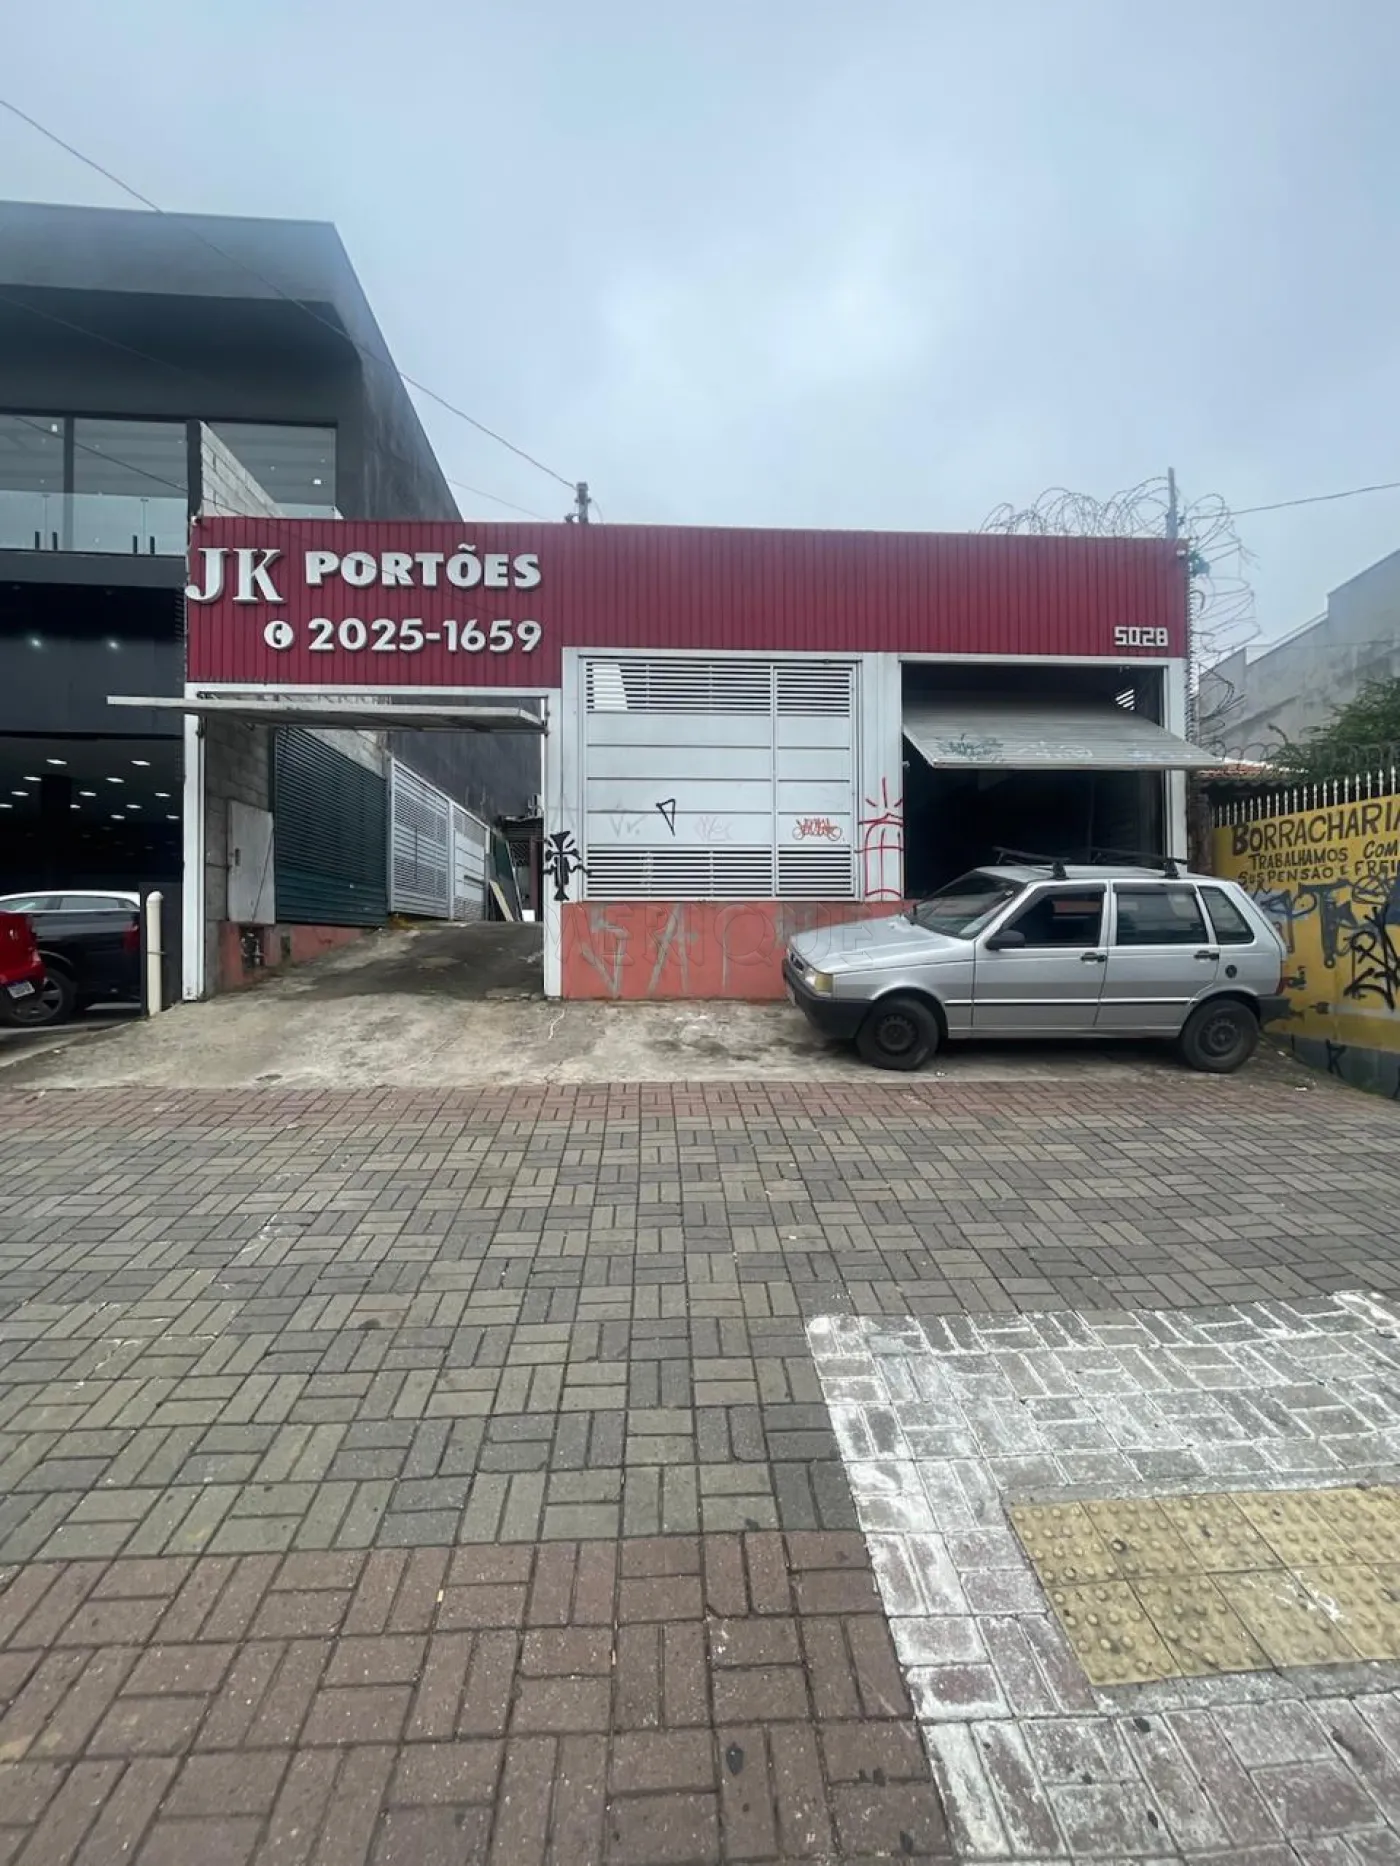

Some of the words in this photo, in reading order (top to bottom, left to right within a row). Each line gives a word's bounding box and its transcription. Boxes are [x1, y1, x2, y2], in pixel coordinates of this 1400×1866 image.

[185, 547, 284, 603] JK
[304, 543, 542, 588] PORTÕES
[307, 617, 542, 652] 2025-1659
[1113, 625, 1169, 647] 5028
[1248, 847, 1348, 870] TRABALHAMOS
